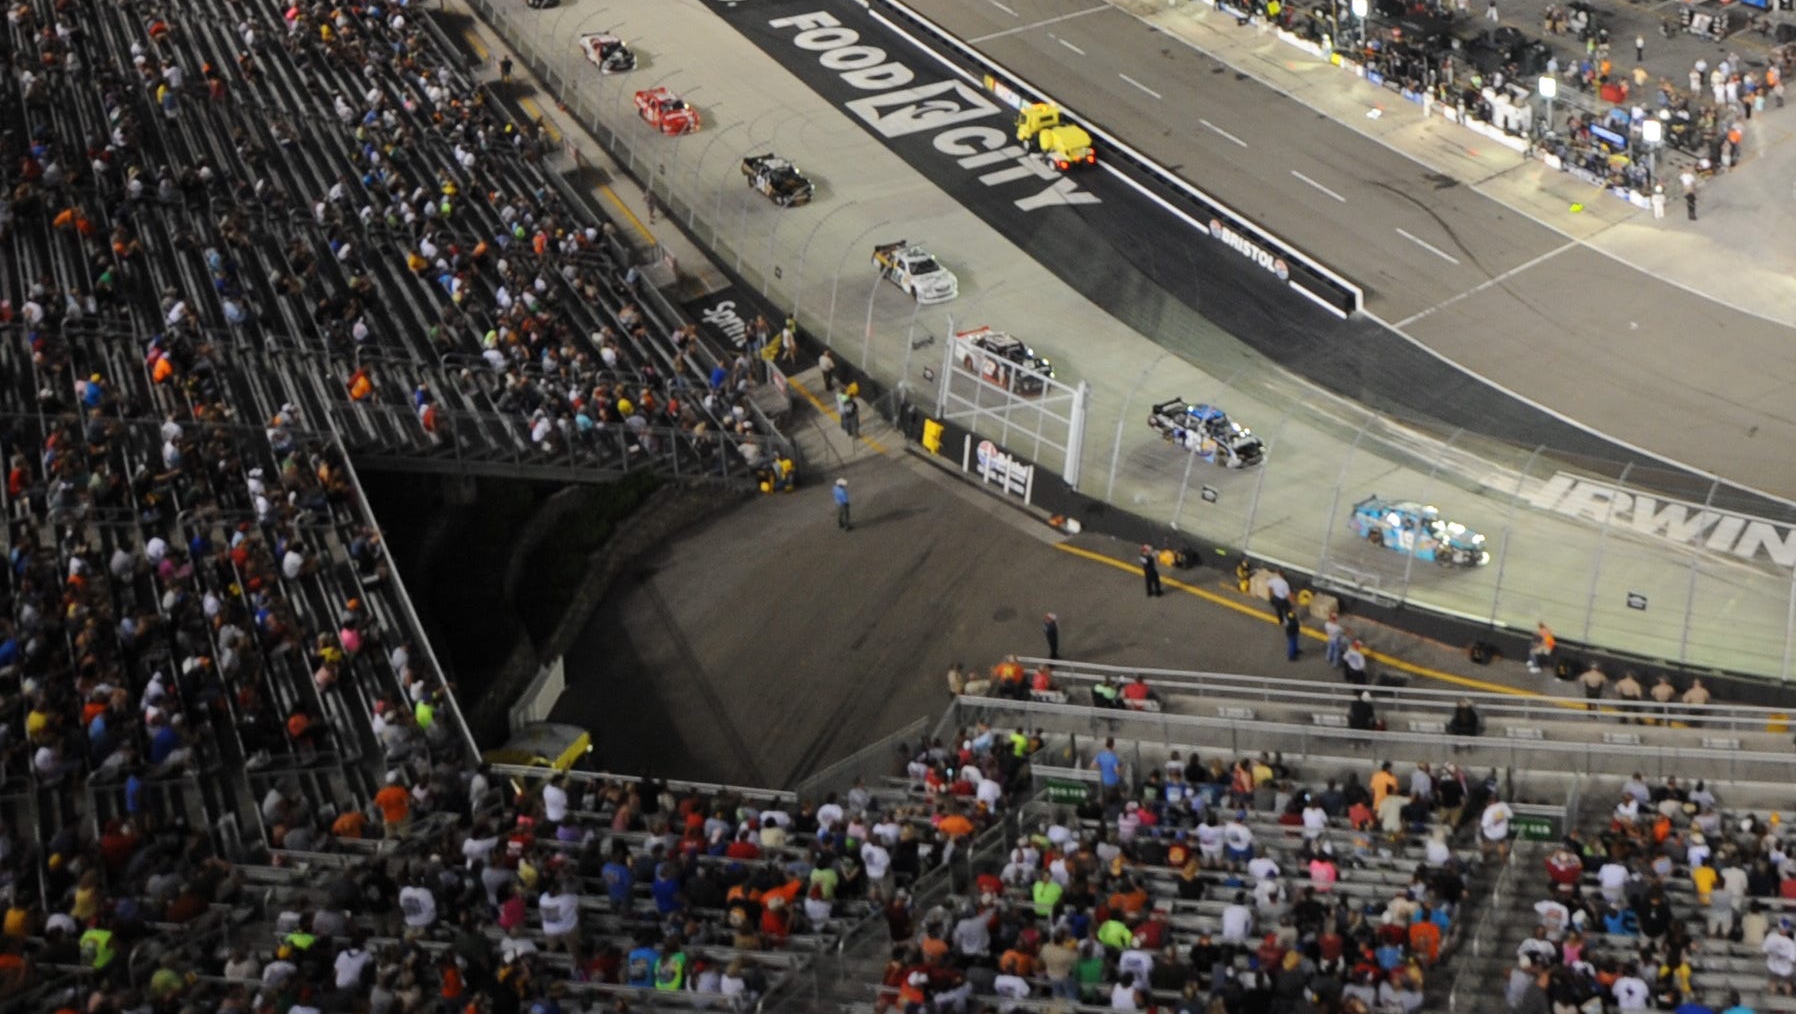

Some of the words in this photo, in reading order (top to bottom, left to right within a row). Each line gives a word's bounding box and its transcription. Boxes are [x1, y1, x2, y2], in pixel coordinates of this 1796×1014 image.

[768, 10, 915, 90] FOOD
[932, 125, 1103, 212] CITY
[1220, 226, 1277, 274] BRISTOL
